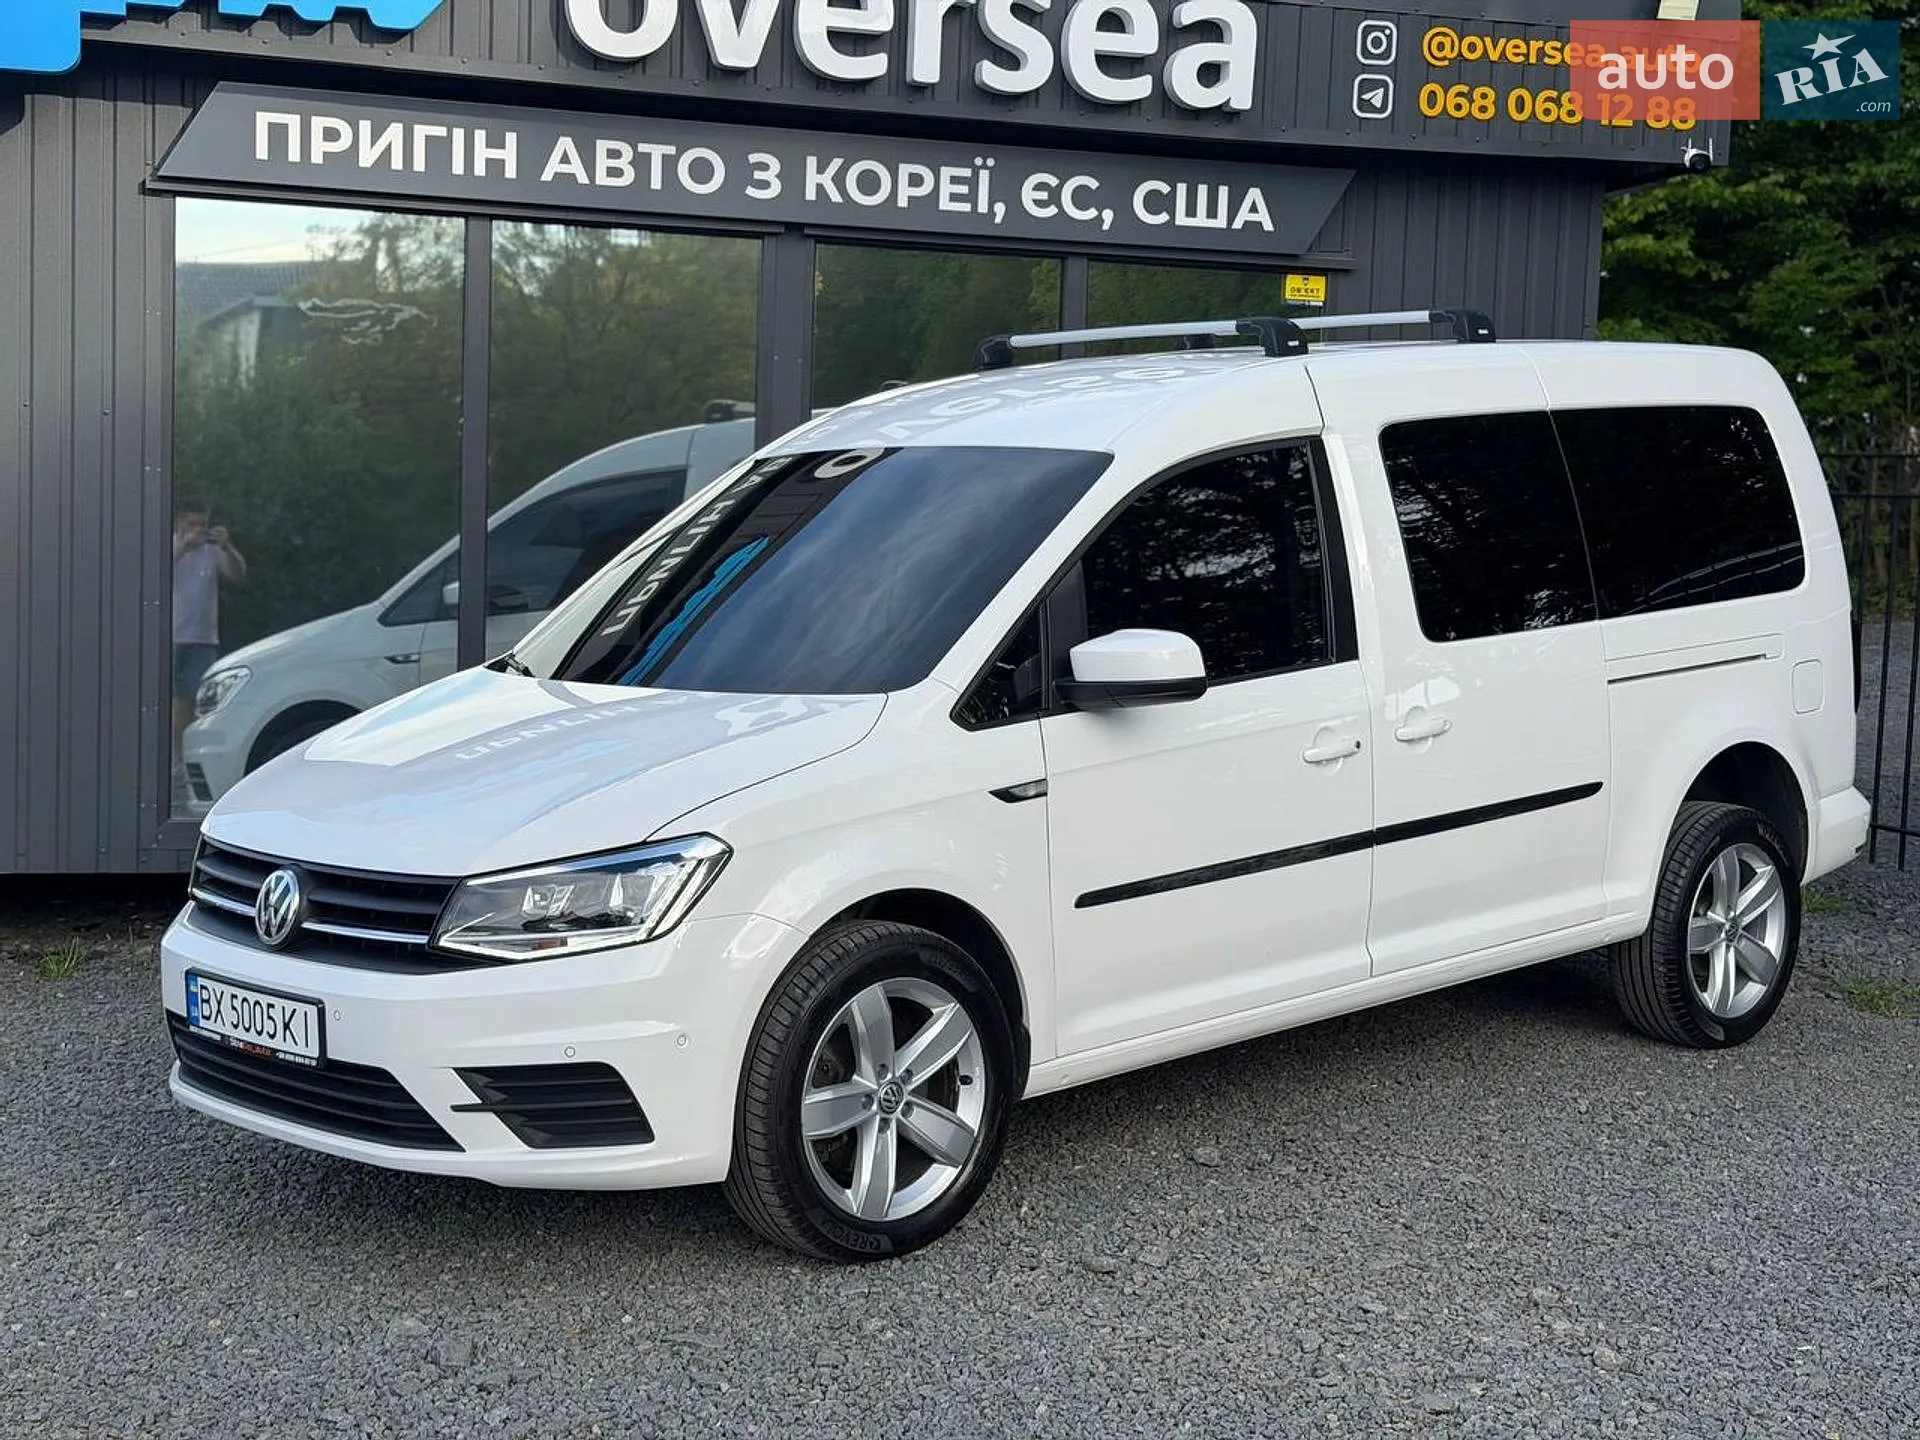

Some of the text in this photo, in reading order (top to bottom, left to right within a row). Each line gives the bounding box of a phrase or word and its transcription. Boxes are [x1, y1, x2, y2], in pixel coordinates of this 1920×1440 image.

[1418, 82, 1697, 131] 068 068 12 88
[254, 110, 518, 179] ПРИГІН
[540, 136, 726, 195] АВТО
[804, 155, 1007, 225] КОРЕЇ,
[1021, 172, 1115, 231] ЄС,
[1132, 179, 1275, 232] США
